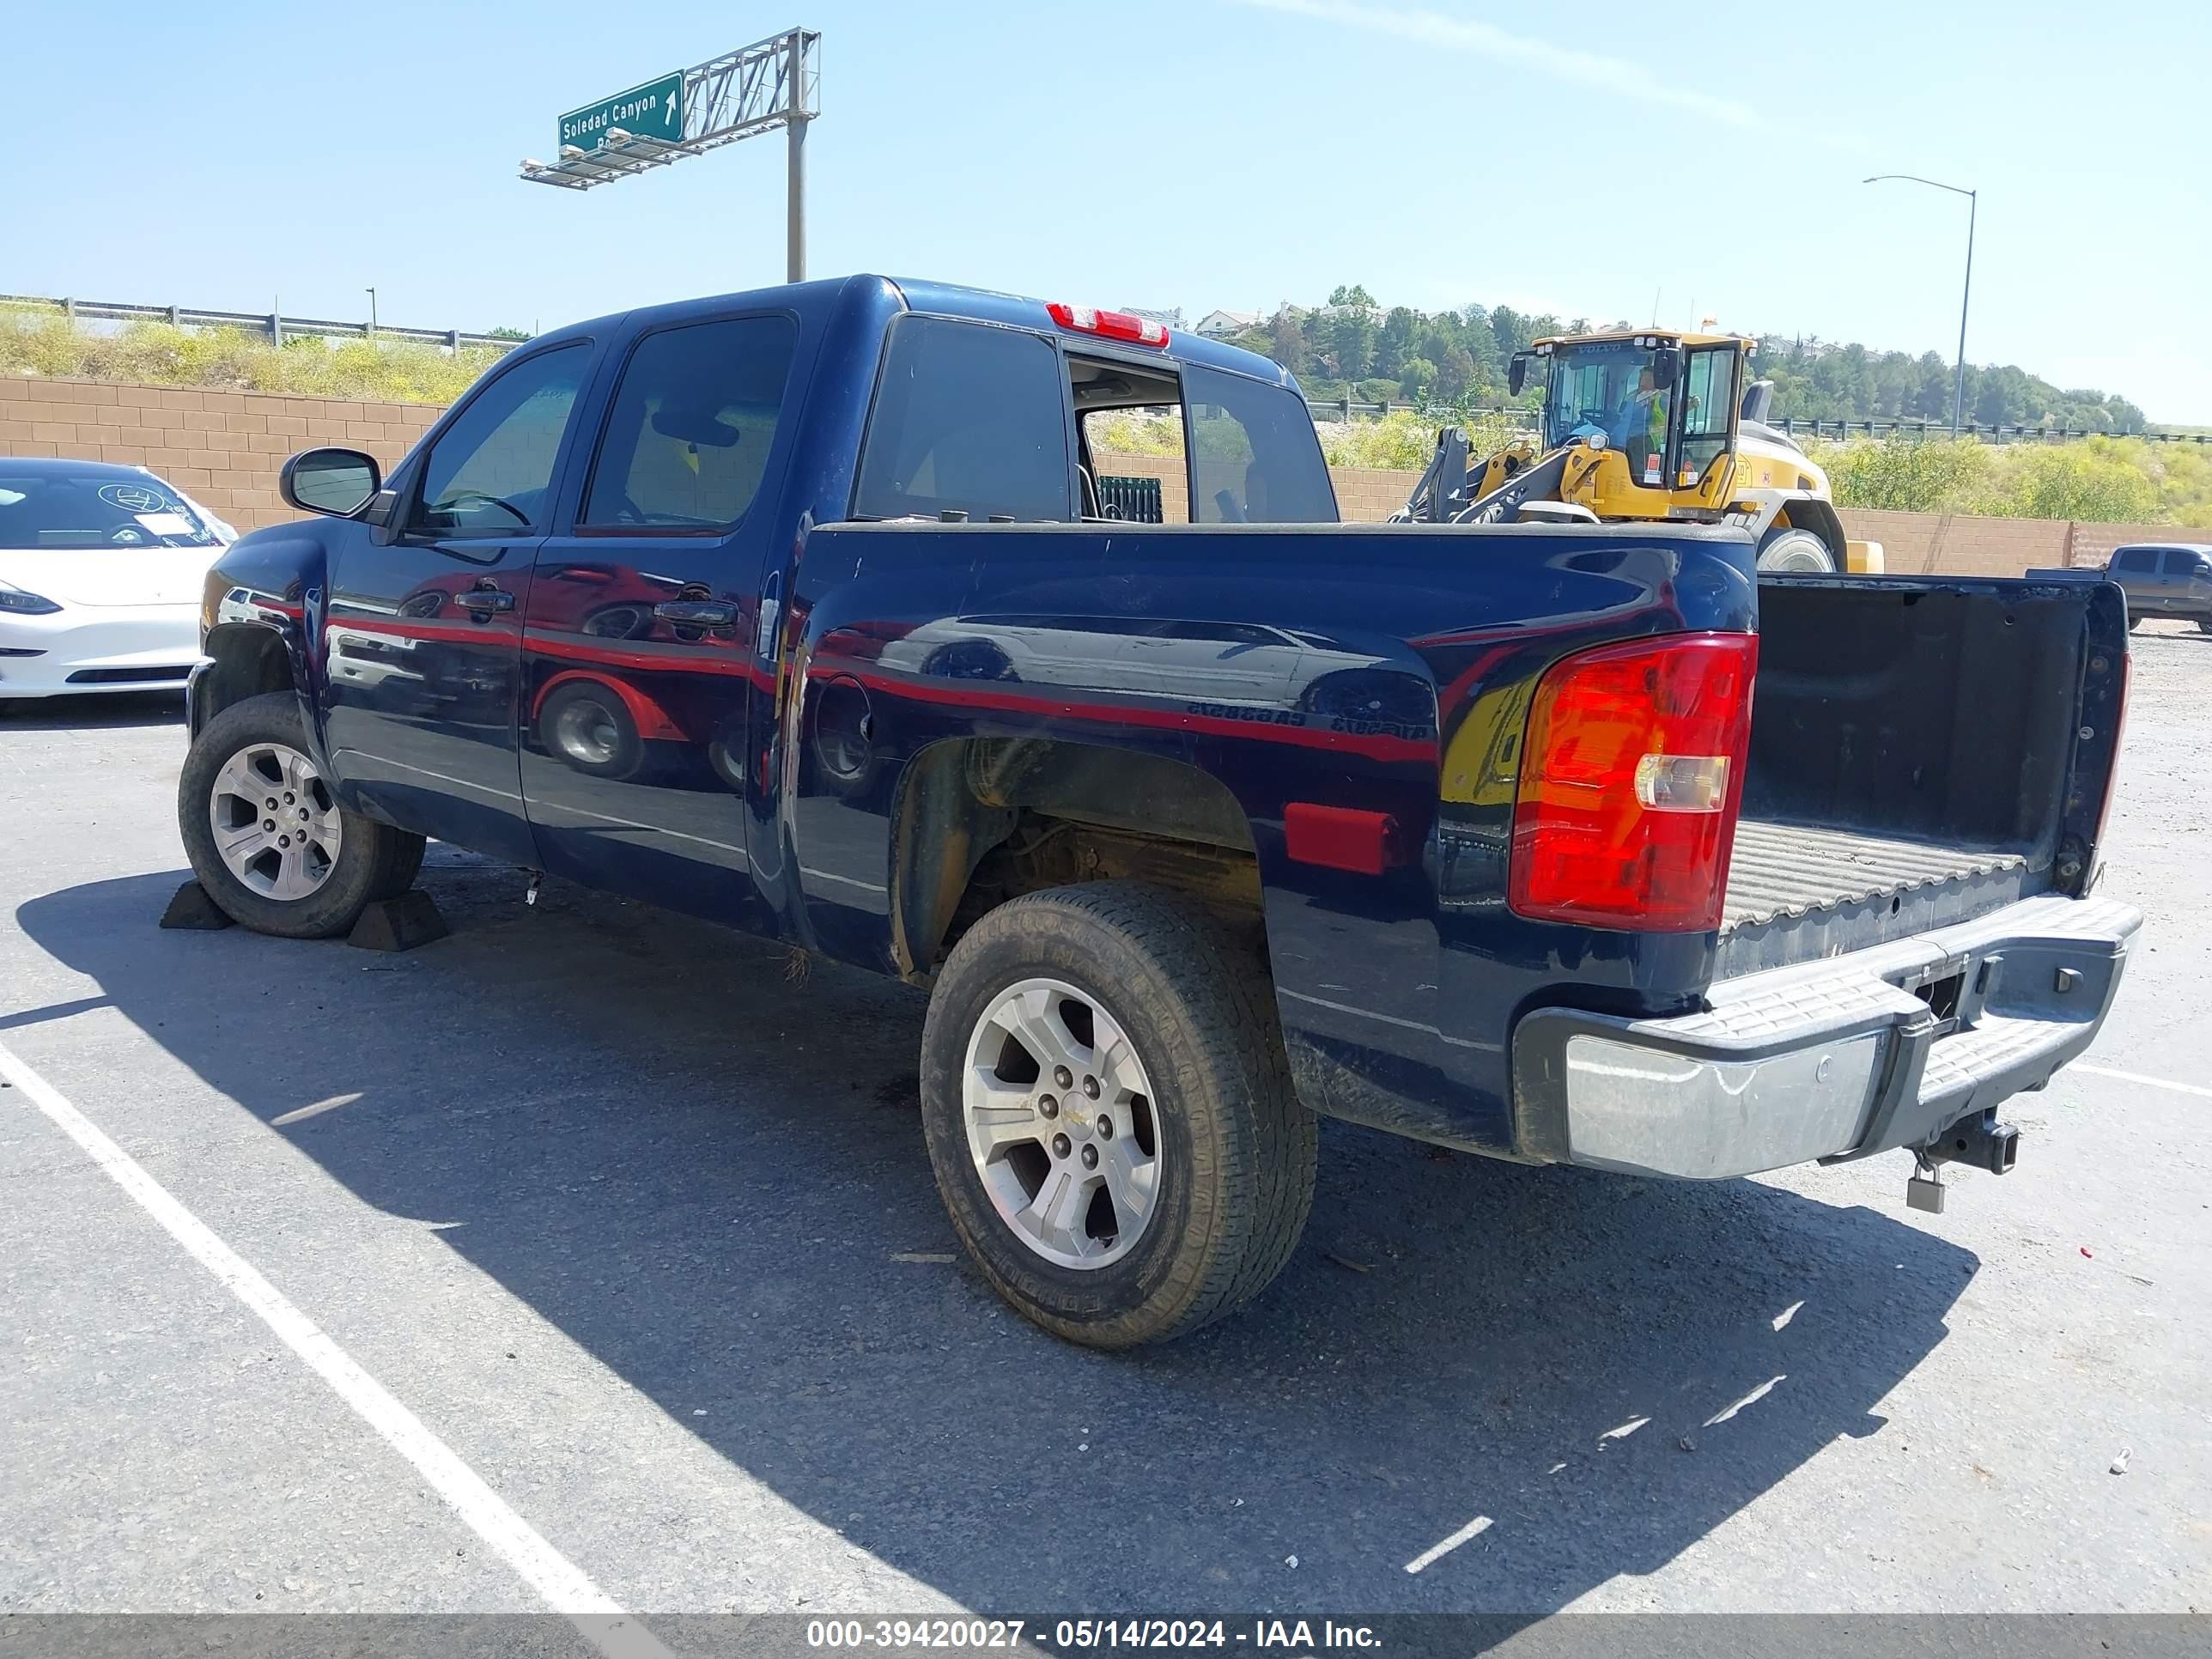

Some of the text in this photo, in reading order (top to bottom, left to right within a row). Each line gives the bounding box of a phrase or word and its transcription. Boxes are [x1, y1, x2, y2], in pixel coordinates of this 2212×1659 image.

[563, 94, 656, 139] Soledad Canyon
[1579, 343, 1621, 354] VOLVO
